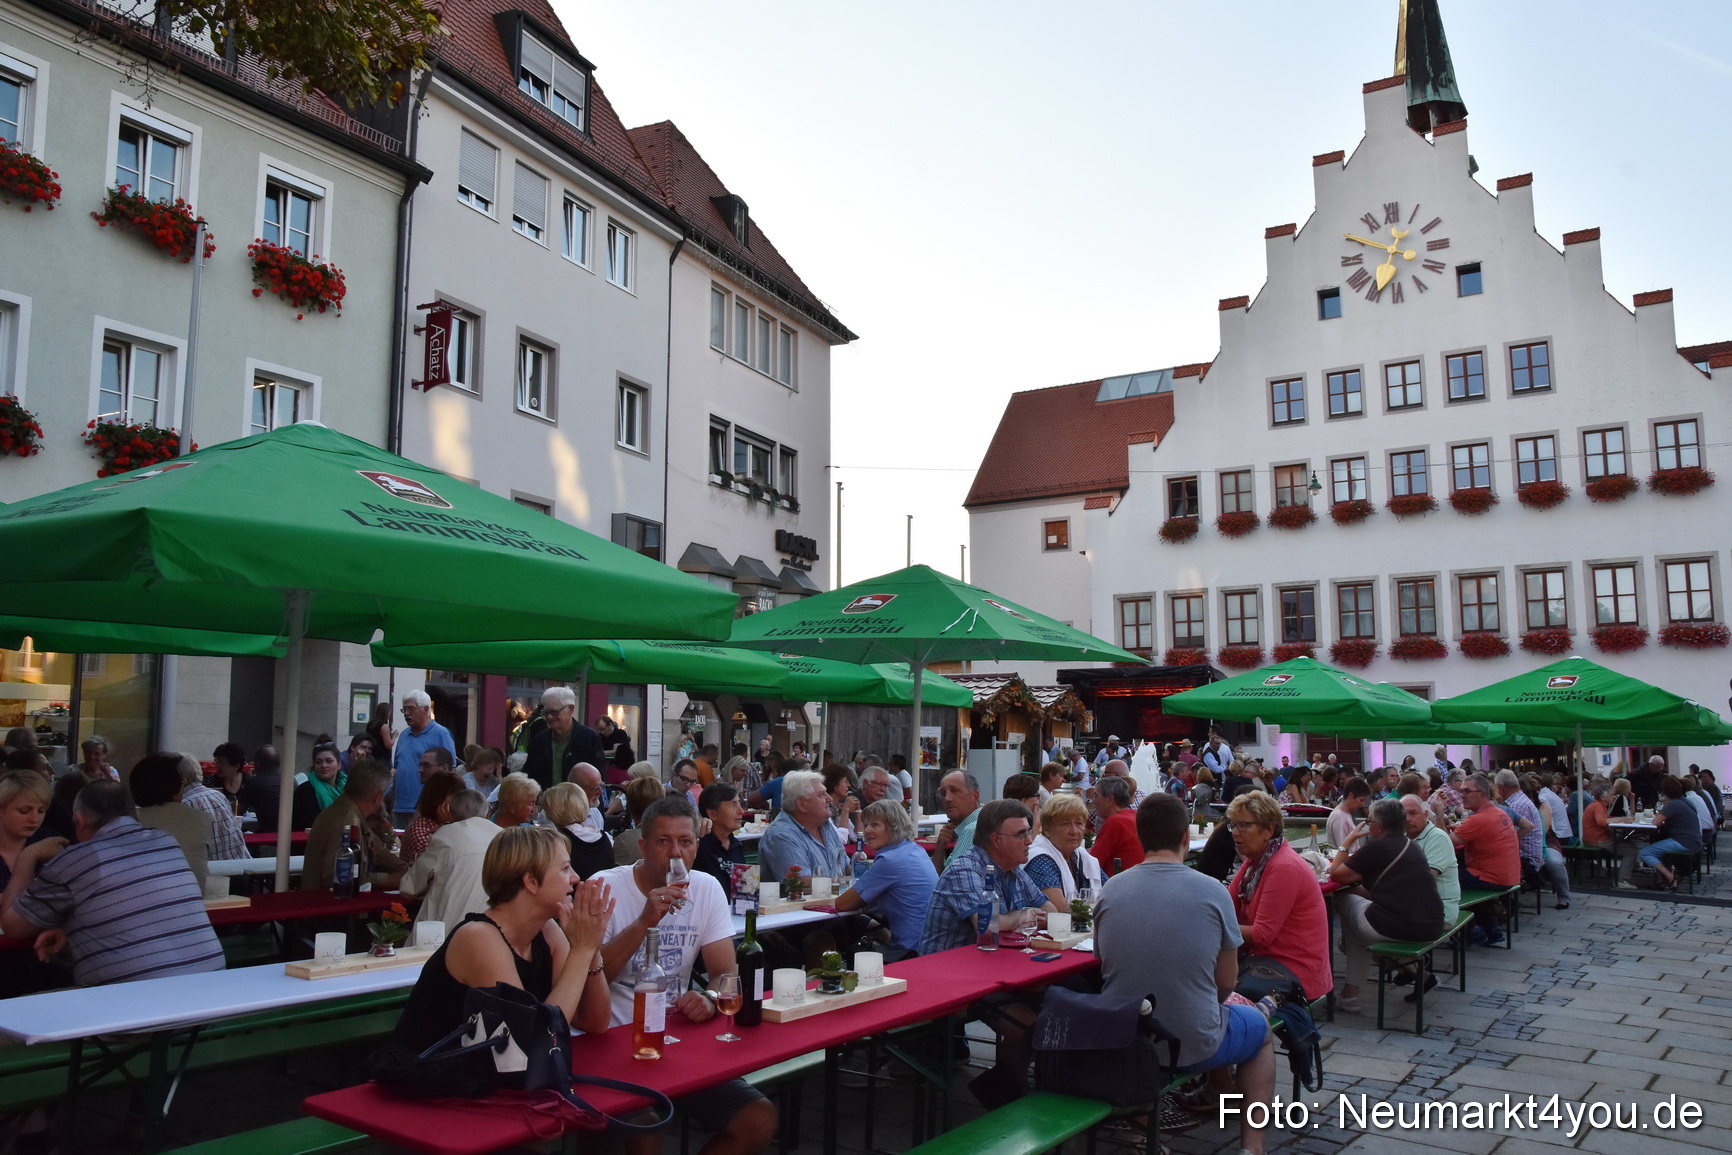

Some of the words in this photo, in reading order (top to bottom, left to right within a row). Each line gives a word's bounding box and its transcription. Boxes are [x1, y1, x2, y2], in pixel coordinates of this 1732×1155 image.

[430, 324, 446, 380] Achatz
[340, 508, 590, 561] Lammsbräu
[360, 501, 533, 539] Neumarkter
[763, 625, 905, 637] Lammsbräu
[796, 617, 898, 627] Neumarkter
